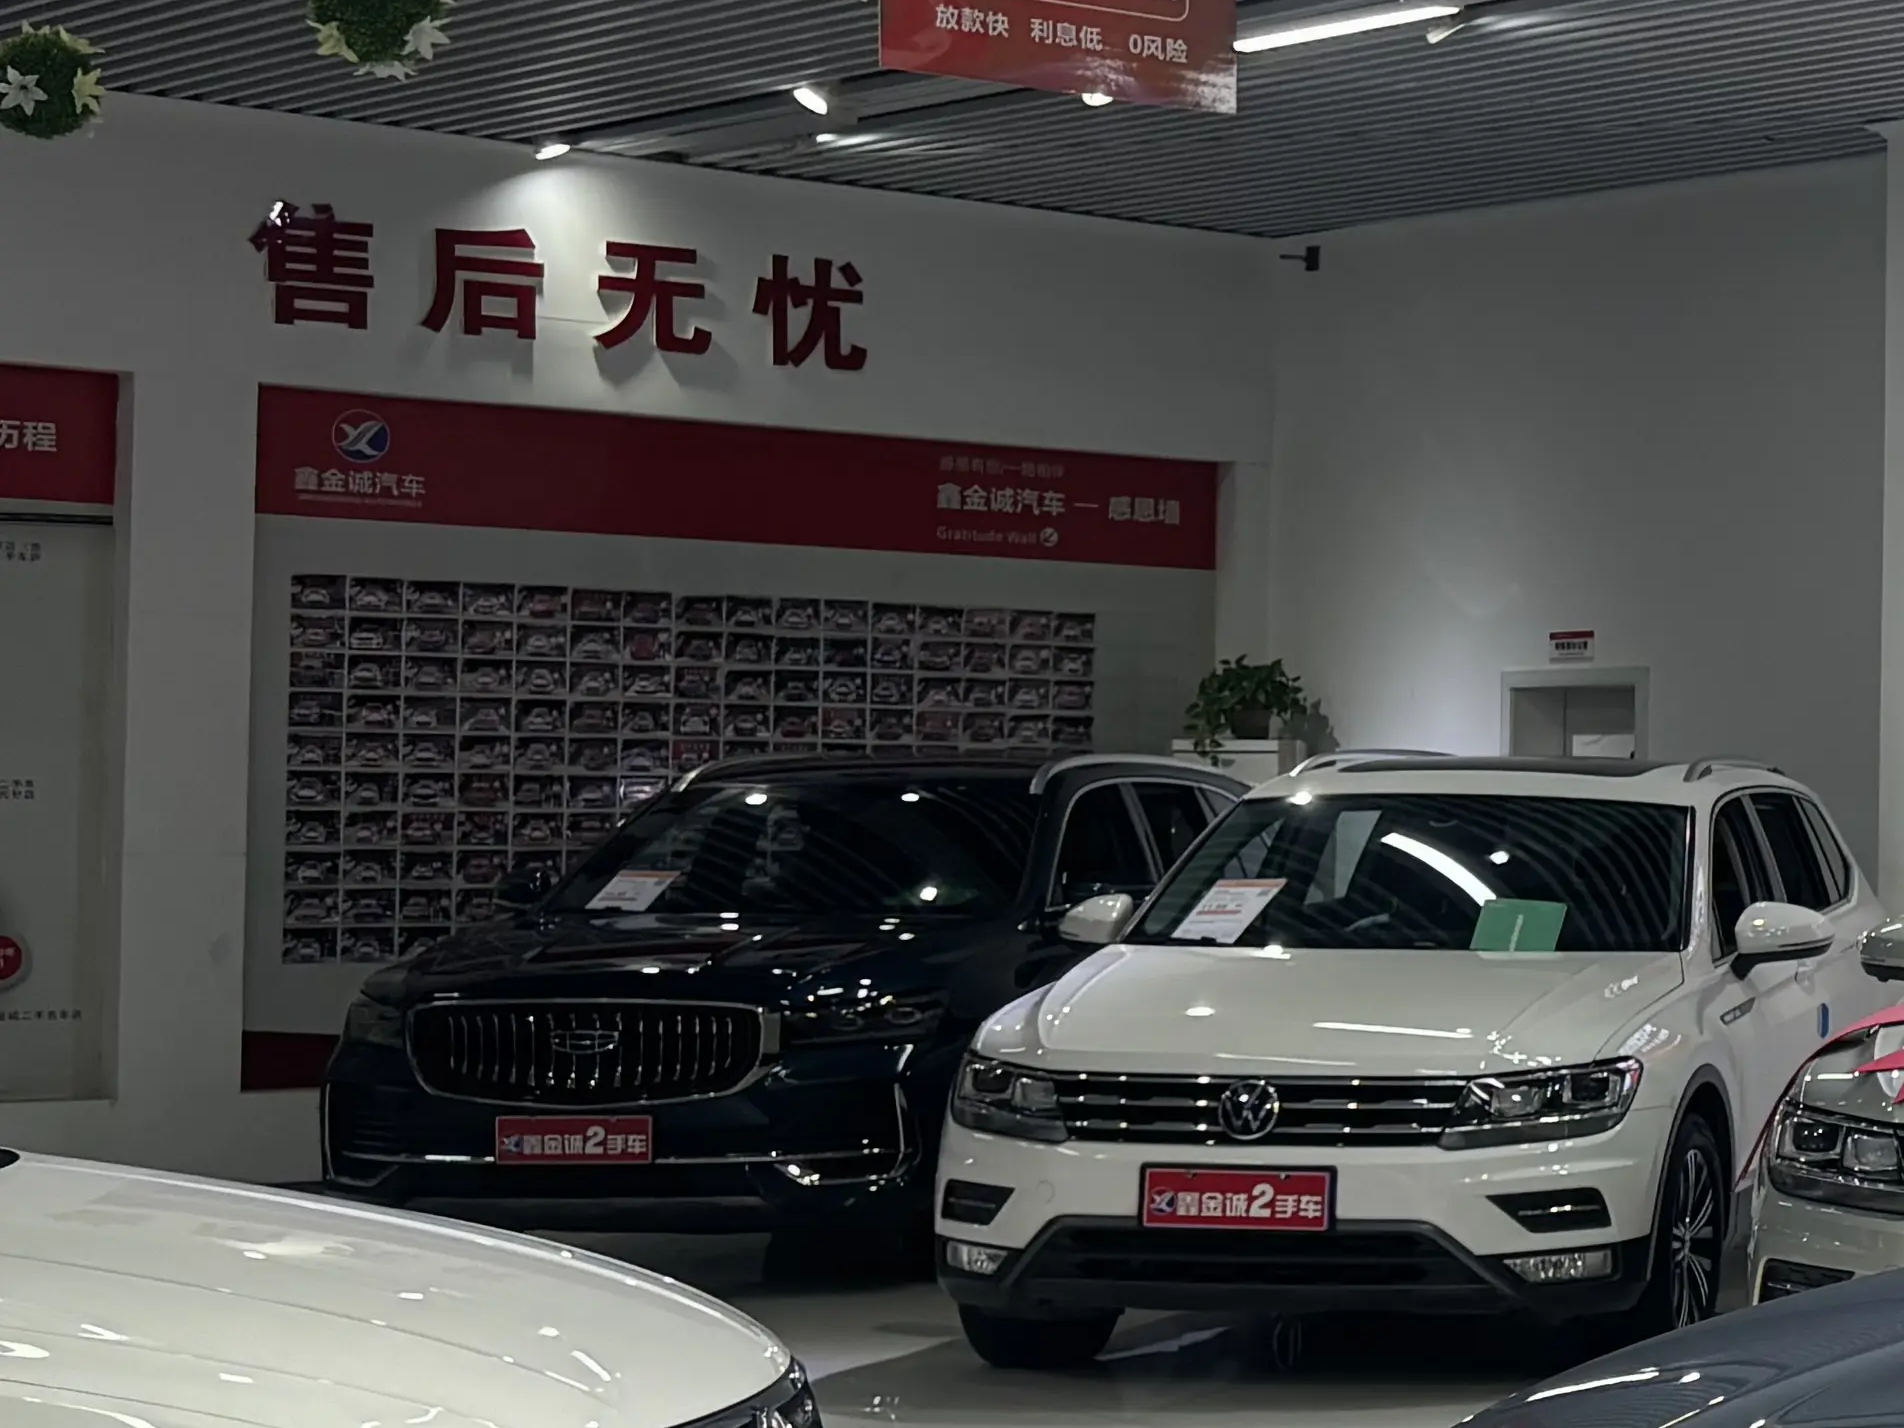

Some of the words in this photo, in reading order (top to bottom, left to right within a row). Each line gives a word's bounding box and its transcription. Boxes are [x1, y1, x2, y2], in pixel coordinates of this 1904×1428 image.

[935, 3, 1009, 38] 放款快
[1030, 18, 1103, 52] 利息低
[1129, 34, 1188, 64] 0风险
[247, 200, 868, 372] 售后无忧
[293, 465, 426, 498] 鑫金诚汽车
[936, 525, 1003, 544] Gratitude
[1007, 528, 1038, 545] Wall
[522, 1125, 647, 1155] 鑫金诚2手车
[1176, 1182, 1323, 1219] 鑫金诚2手车
